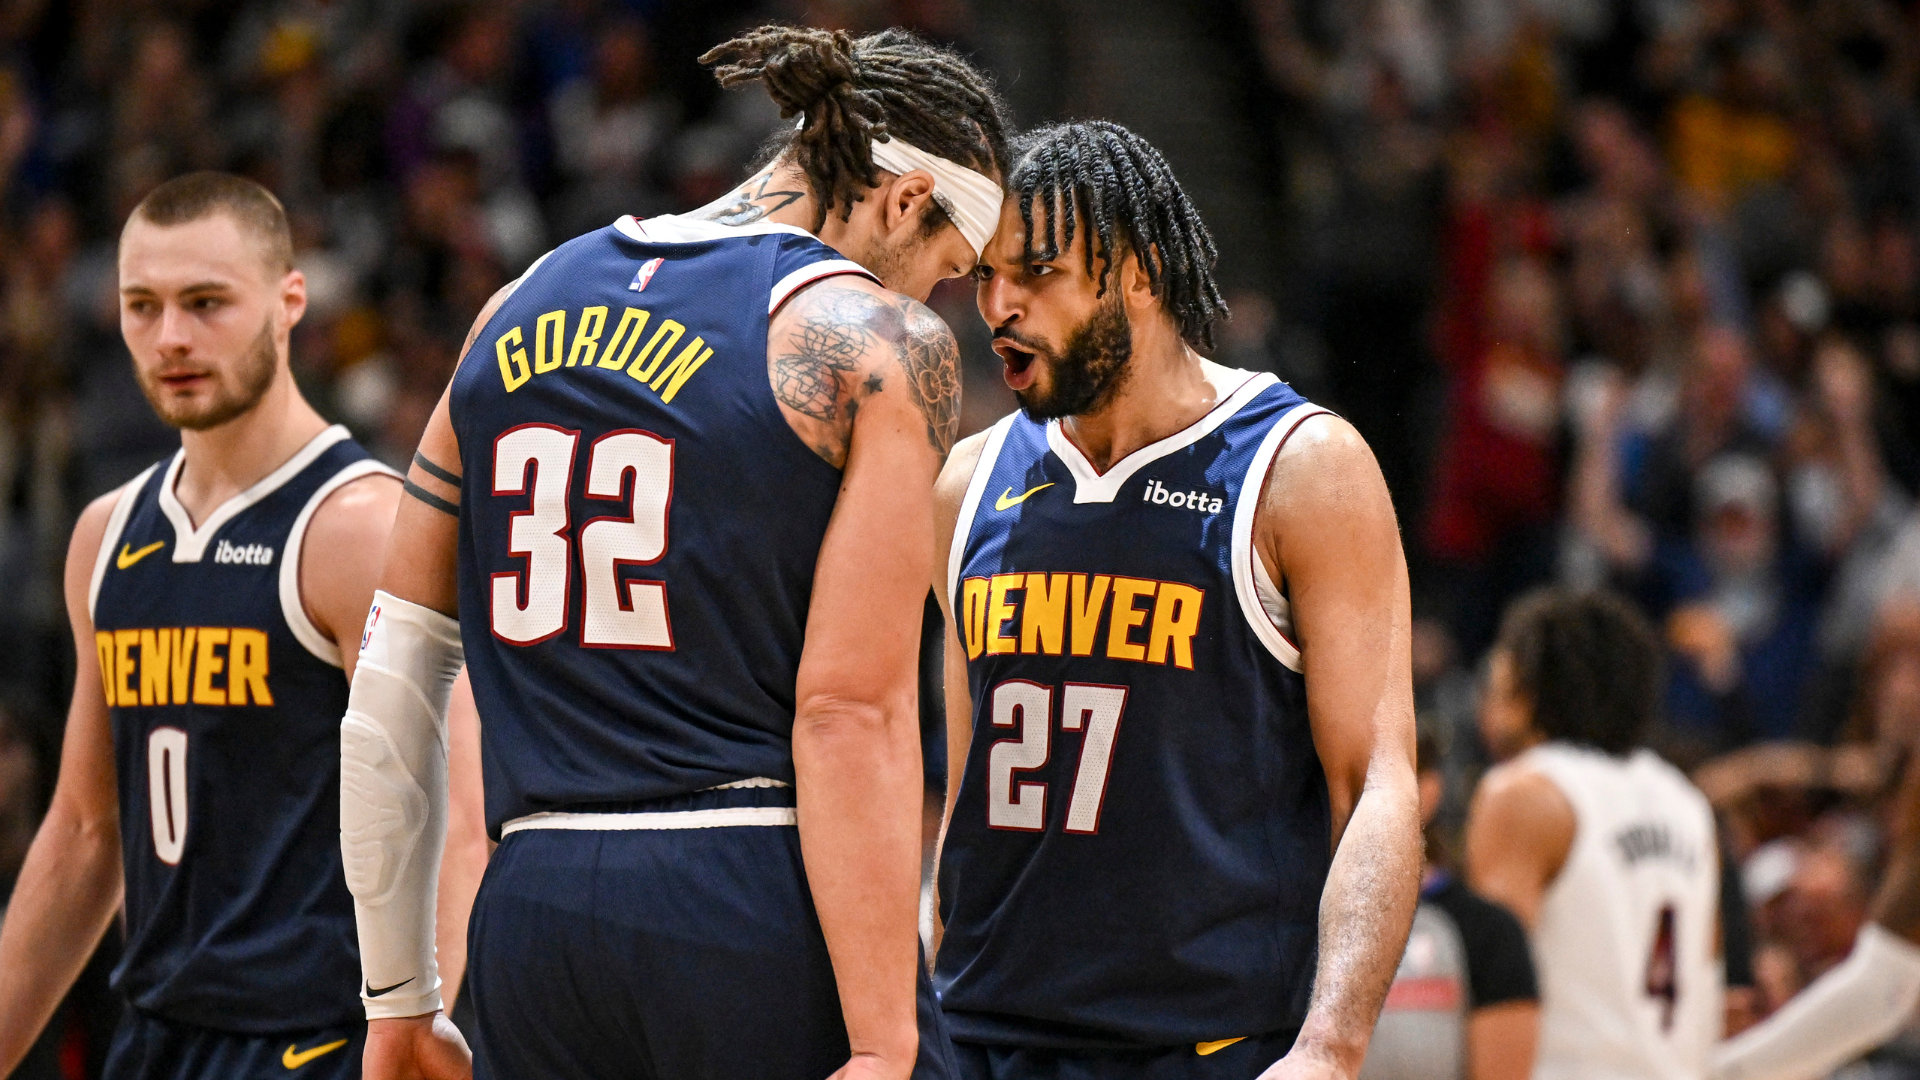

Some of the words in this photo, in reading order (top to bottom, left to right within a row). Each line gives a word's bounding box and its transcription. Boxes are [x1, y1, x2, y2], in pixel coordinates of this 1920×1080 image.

[495, 306, 714, 405] GORDON
[490, 422, 676, 652] 32
[1143, 479, 1223, 514] ibotta
[214, 539, 273, 566] ibotta
[95, 626, 275, 707] DENVER
[963, 572, 1205, 671] DENVER
[148, 727, 188, 866] 0
[987, 678, 1130, 835] 27
[1643, 902, 1679, 1035] 4
